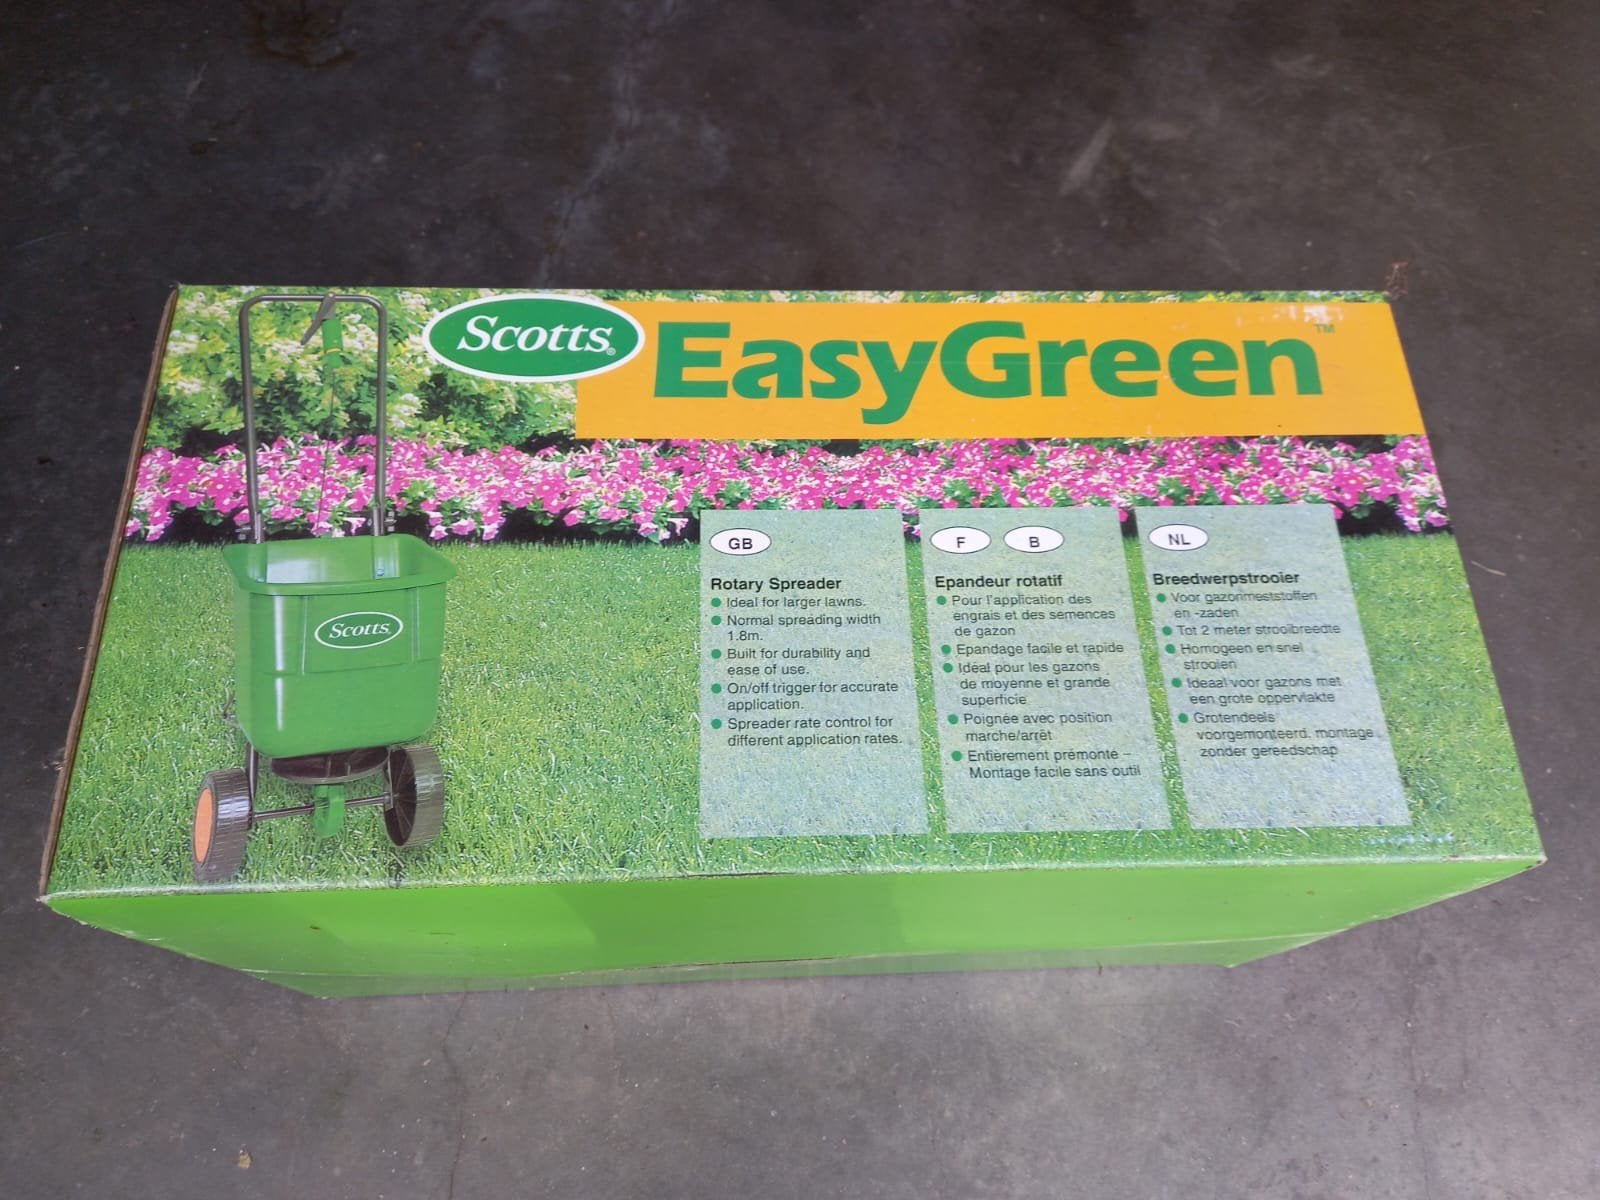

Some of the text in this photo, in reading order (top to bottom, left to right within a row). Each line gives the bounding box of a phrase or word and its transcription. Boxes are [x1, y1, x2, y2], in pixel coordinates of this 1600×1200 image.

[654, 320, 1323, 425] EasyGreen
[728, 538, 752, 549] GB
[957, 537, 965, 548] F
[1029, 537, 1040, 547] B
[1168, 534, 1191, 545] NL
[711, 578, 842, 592] Rotary Spreader
[935, 575, 1063, 590] Epandeur rotatif
[1153, 573, 1300, 587] Breedwerpstrooier
[727, 597, 866, 609] Ideal for larger lawns.
[952, 596, 981, 606] Pour
[1068, 594, 1092, 605] des
[1171, 591, 1317, 604] Voor gazonmeststoffen
[953, 609, 1116, 622] engrais et des semences
[1174, 608, 1239, 618] en -zaden
[727, 614, 881, 627] Normal spreading width
[329, 623, 390, 638] Scotts
[728, 631, 763, 641] 1.8m.
[954, 626, 1015, 638] de gazon
[1176, 624, 1341, 636] Tot 2 meter strooibreedte
[728, 647, 870, 660] Built for durability and
[957, 642, 1124, 656] Epandage facile et rapide
[1181, 642, 1303, 656] Homogeen en snel
[728, 664, 810, 675] ease of use.
[995, 664, 1024, 675] pour
[1029, 662, 1048, 672] les
[1053, 662, 1100, 674] gazons
[1184, 659, 1237, 669] strooien
[728, 682, 899, 695] On/off trigger for accurate
[960, 677, 1111, 691] de moyenne et grande
[1187, 676, 1341, 690] Ideaal voor gazons met
[728, 699, 804, 712] application.
[961, 694, 1027, 707] superficie
[1190, 693, 1335, 706] een grote oppervlakte
[728, 716, 893, 731] Spreader rate control for
[964, 712, 1112, 727] Poignée avec position
[1193, 712, 1275, 723] Grotendeels
[728, 734, 902, 747] different application rates.
[1315, 728, 1373, 740] montage
[1200, 745, 1338, 759] zonder gereedschap
[969, 765, 1141, 780] Montage facile sans outil
